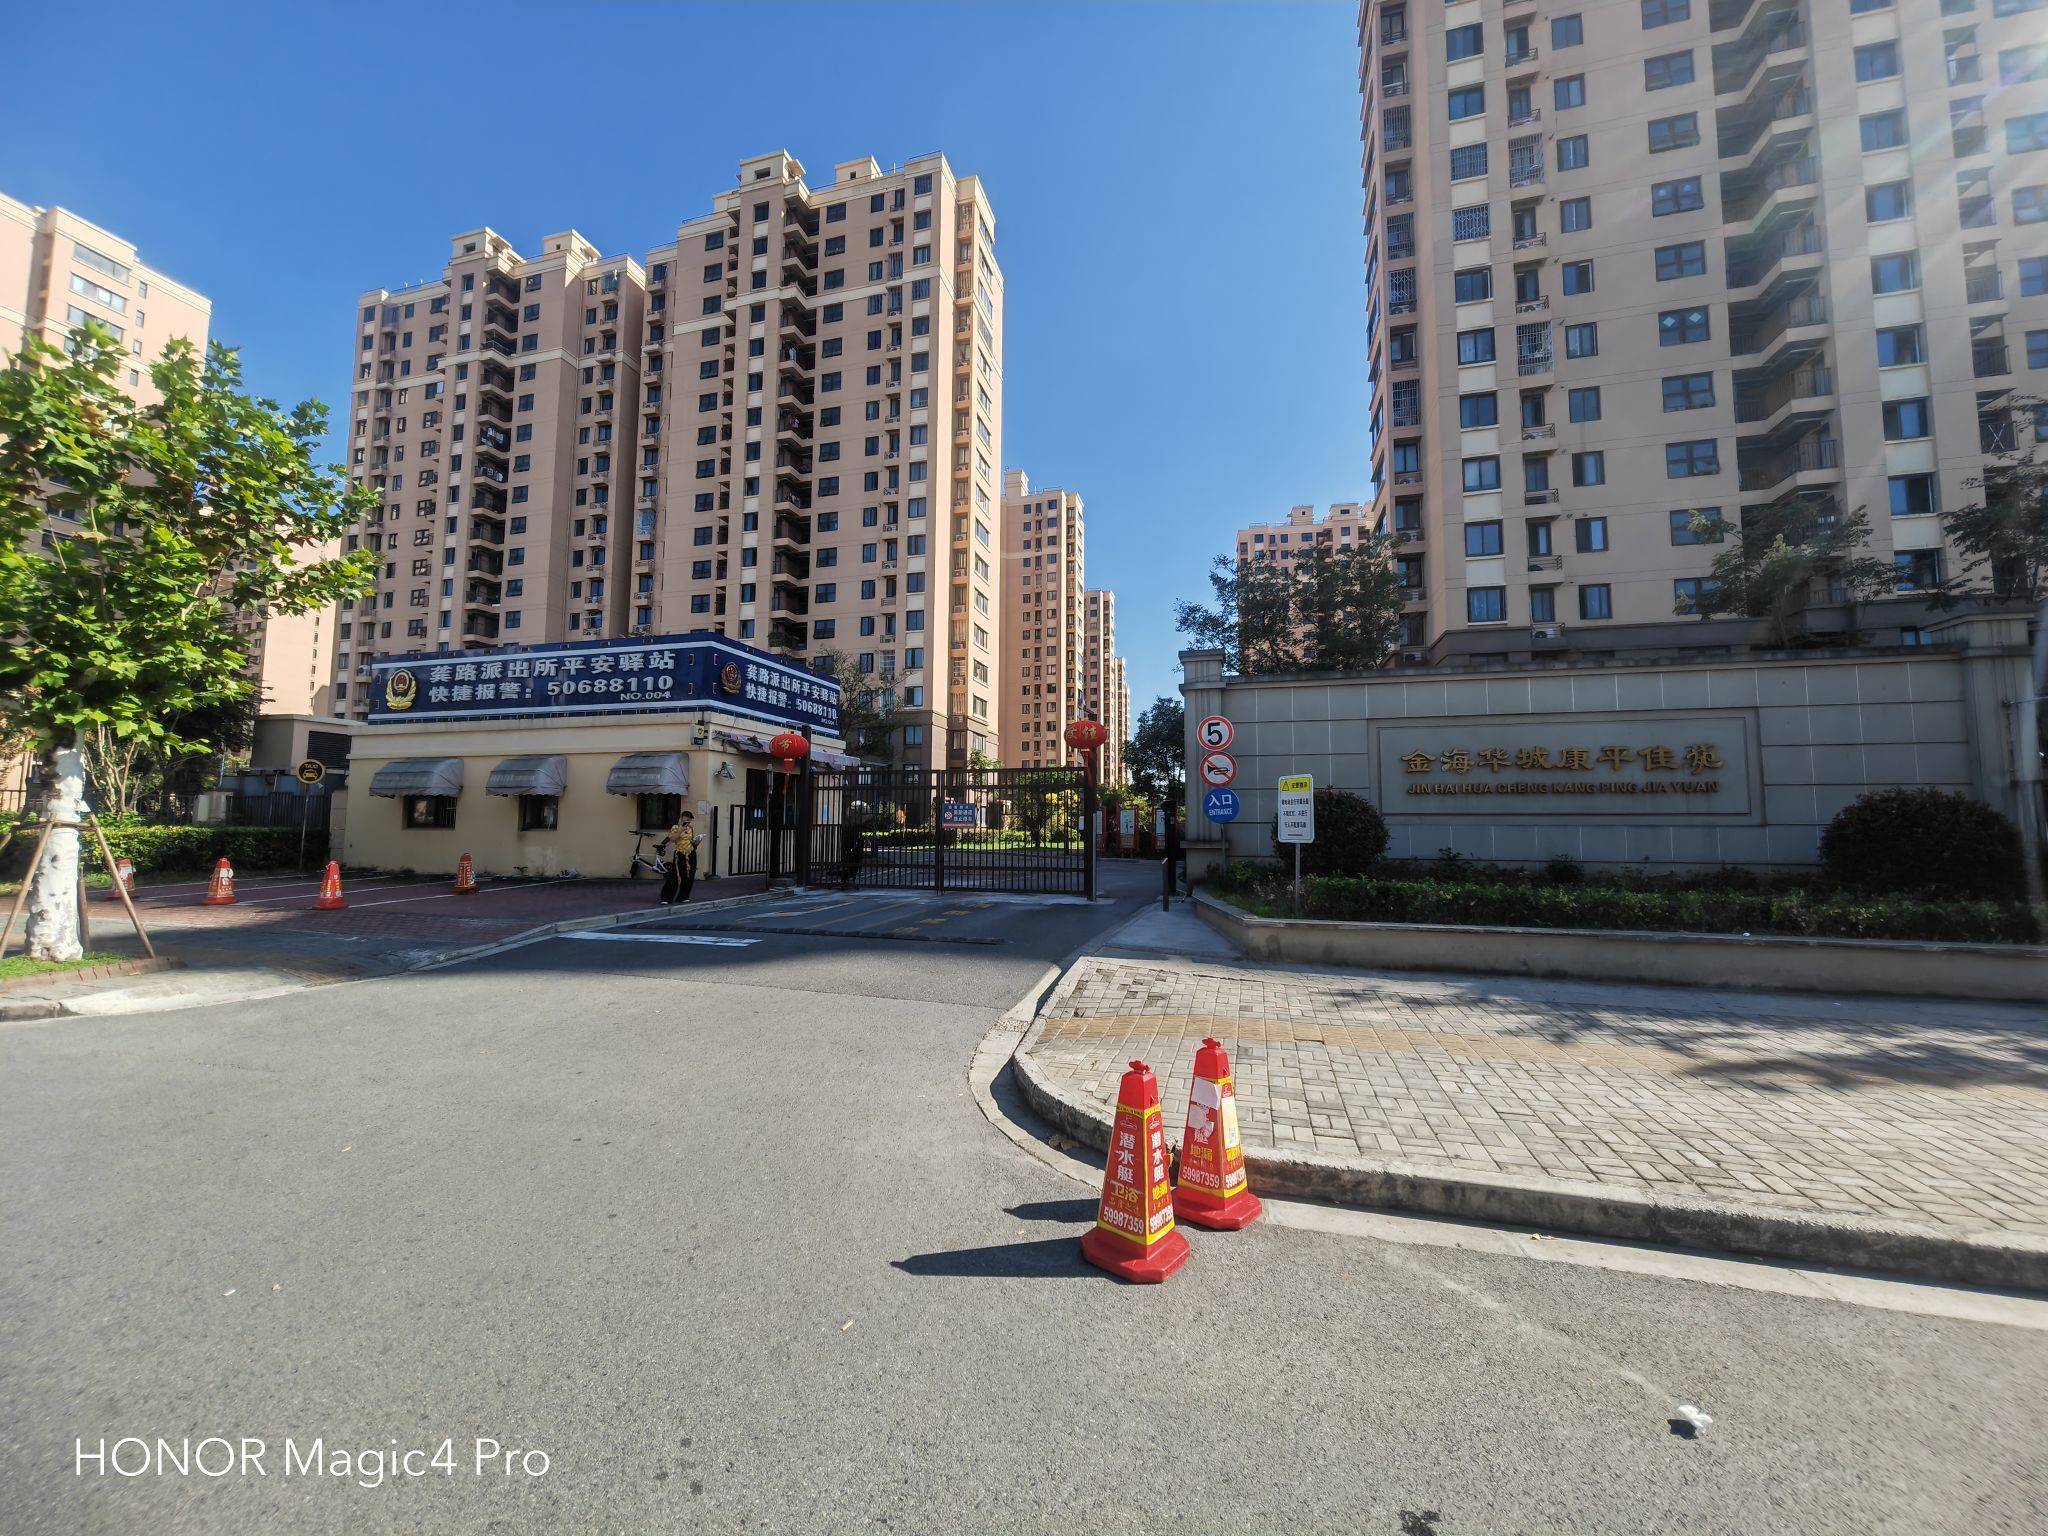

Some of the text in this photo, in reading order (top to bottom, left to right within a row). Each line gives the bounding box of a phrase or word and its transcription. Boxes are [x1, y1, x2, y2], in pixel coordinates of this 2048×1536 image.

[430, 651, 676, 683] 龚路派出所平安驿站
[547, 675, 674, 696] 50688110
[620, 690, 672, 701] NO.004
[796, 698, 838, 720] 50688110
[1207, 722, 1223, 746] 5
[1401, 744, 1724, 776] 金海华城康平佳苑
[1408, 781, 1721, 794] JIN HAI HUA CHENG KANG PING JIA YUAN
[1208, 794, 1232, 806] 入口
[1208, 807, 1233, 816] ENTRANCE
[1116, 1132, 1135, 1183] 潜水艇
[1151, 1131, 1164, 1183] 潜水艇
[1182, 1165, 1220, 1189] 59987359
[1110, 1180, 1141, 1203] 卫浴
[1103, 1205, 1144, 1234] 59987359
